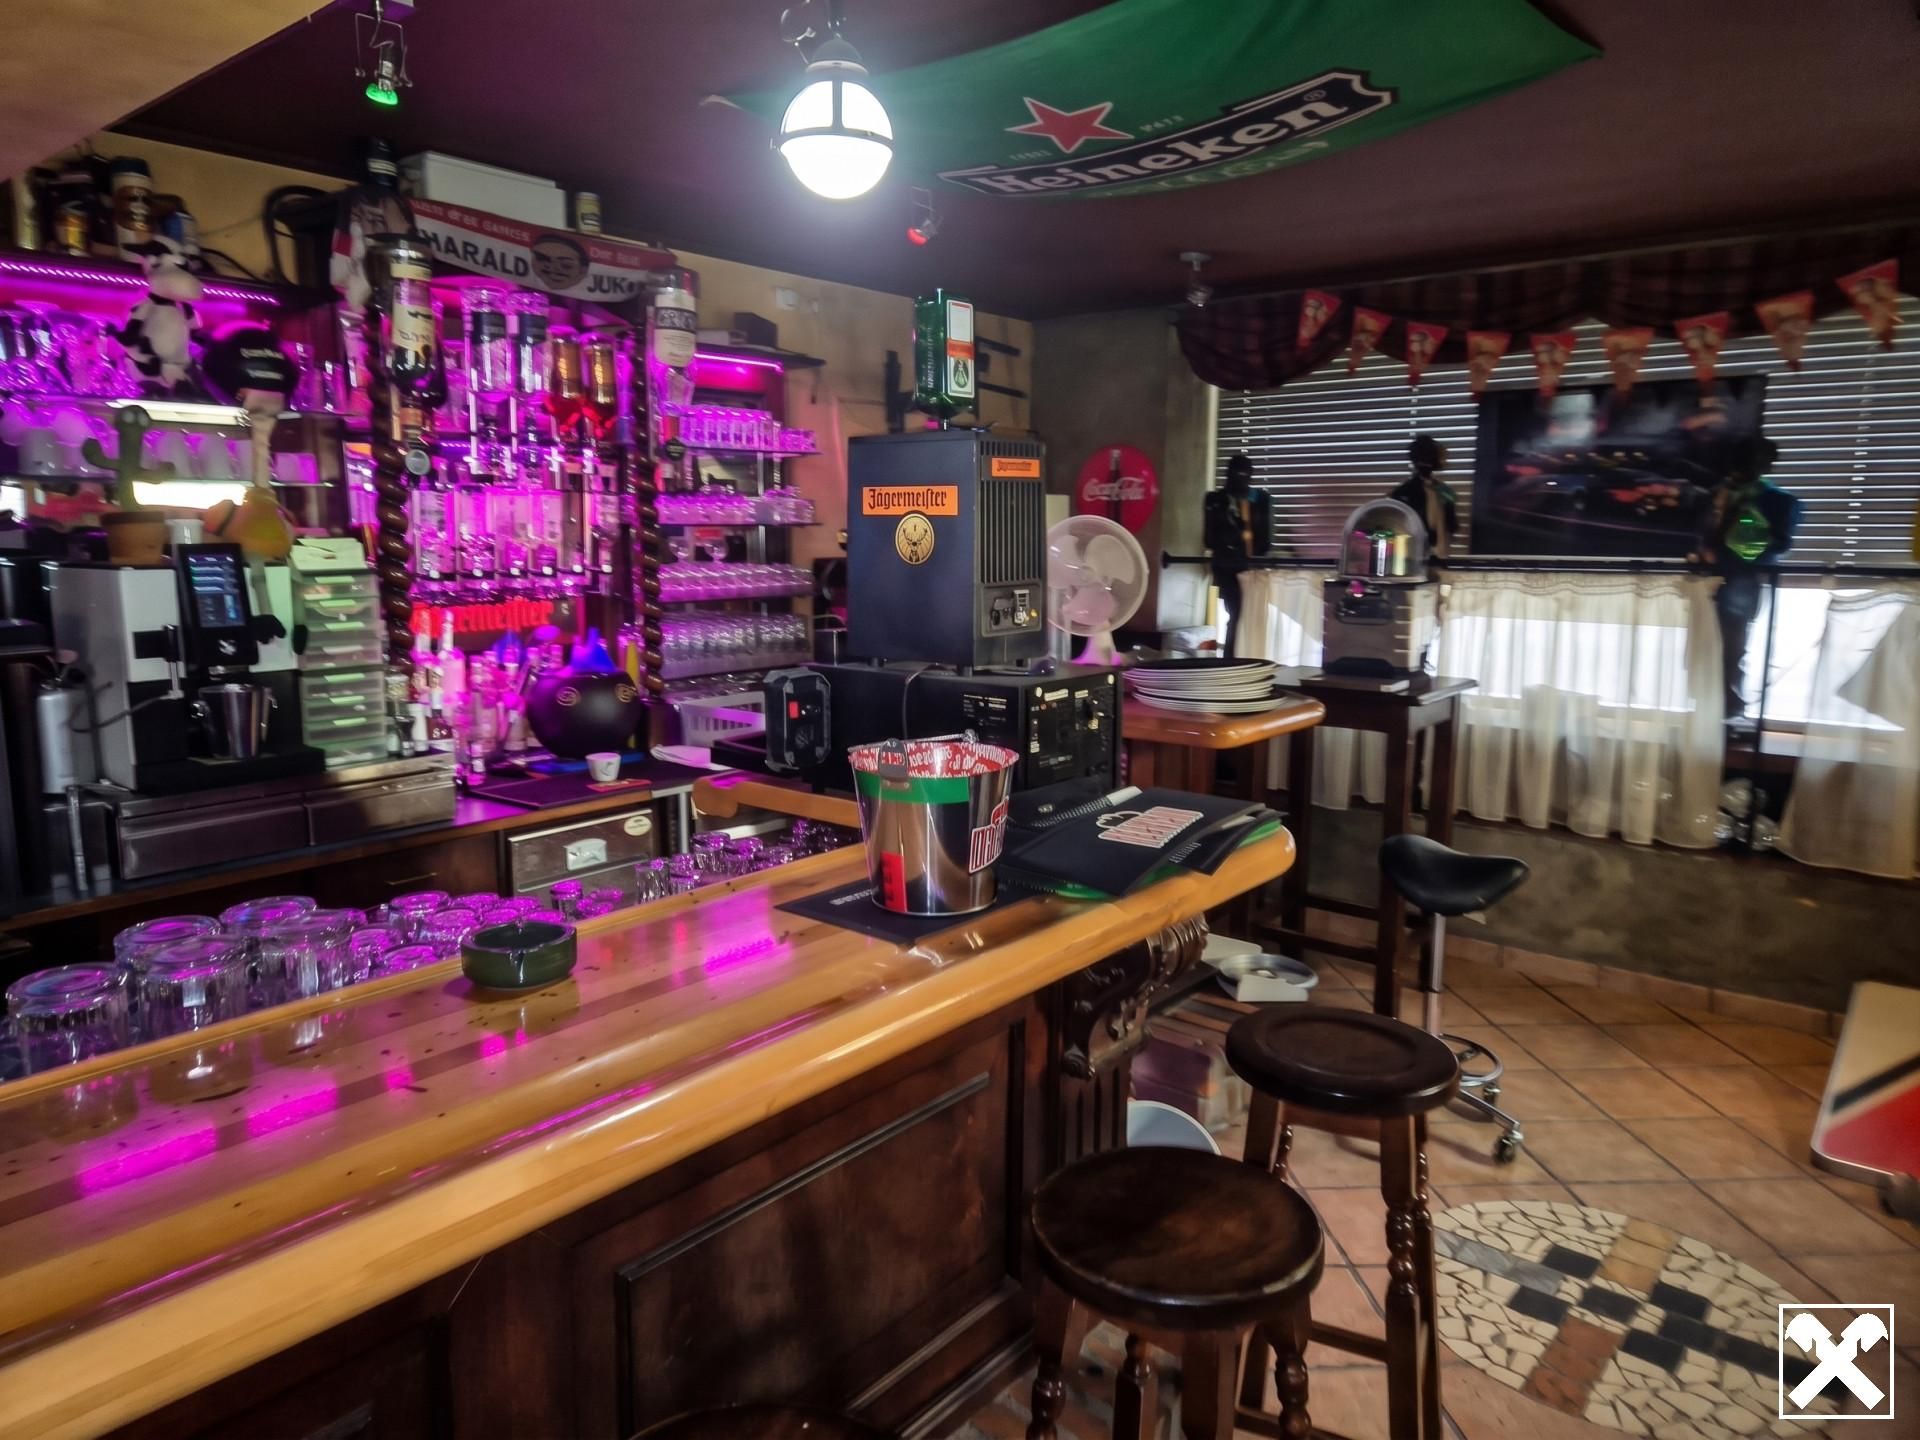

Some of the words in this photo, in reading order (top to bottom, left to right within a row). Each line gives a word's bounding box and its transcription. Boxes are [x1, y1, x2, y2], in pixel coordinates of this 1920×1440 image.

[968, 101, 1349, 193] Heineken
[418, 228, 529, 278] HARALD
[867, 488, 947, 510] Jägermeister
